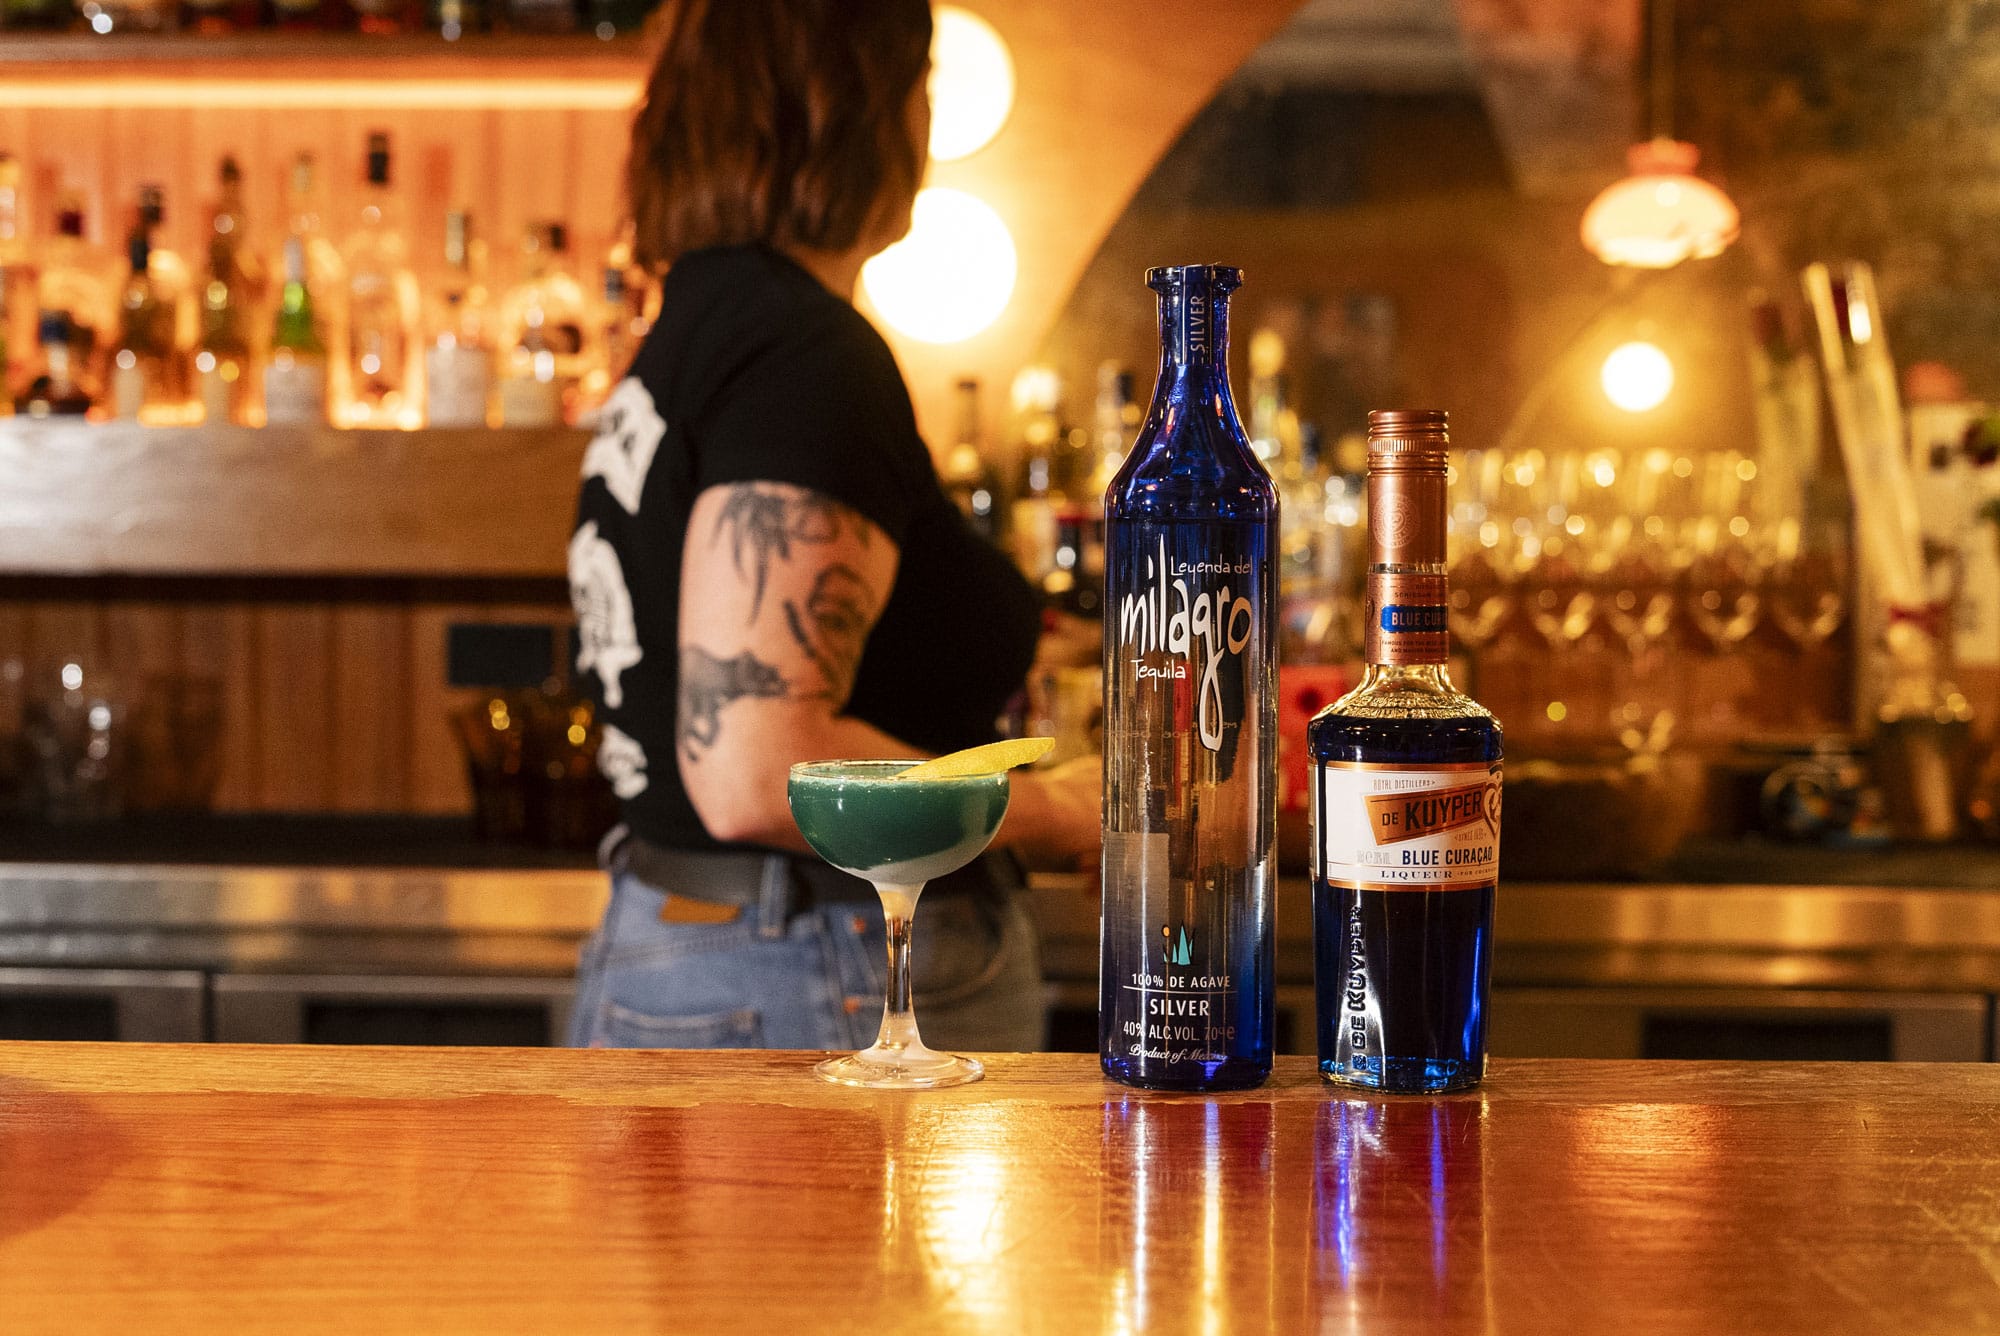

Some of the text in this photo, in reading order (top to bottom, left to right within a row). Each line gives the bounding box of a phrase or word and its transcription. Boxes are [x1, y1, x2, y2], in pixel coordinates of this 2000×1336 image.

[1190, 295, 1206, 354] SILVER
[1170, 553, 1253, 584] Leyenda del
[1391, 612, 1421, 626] BLUE
[1121, 533, 1252, 752] milagro
[1130, 659, 1187, 692] Tequila
[1382, 790, 1482, 832] DE KUYPER
[1402, 845, 1493, 866] BLUE CURAÇAO
[1381, 870, 1453, 880] LIQUEUR
[1131, 973, 1231, 988] 100% DE AGAVE
[1149, 998, 1209, 1017] SILVER
[1123, 1020, 1145, 1038] 40%
[1169, 1048, 1186, 1064] of
